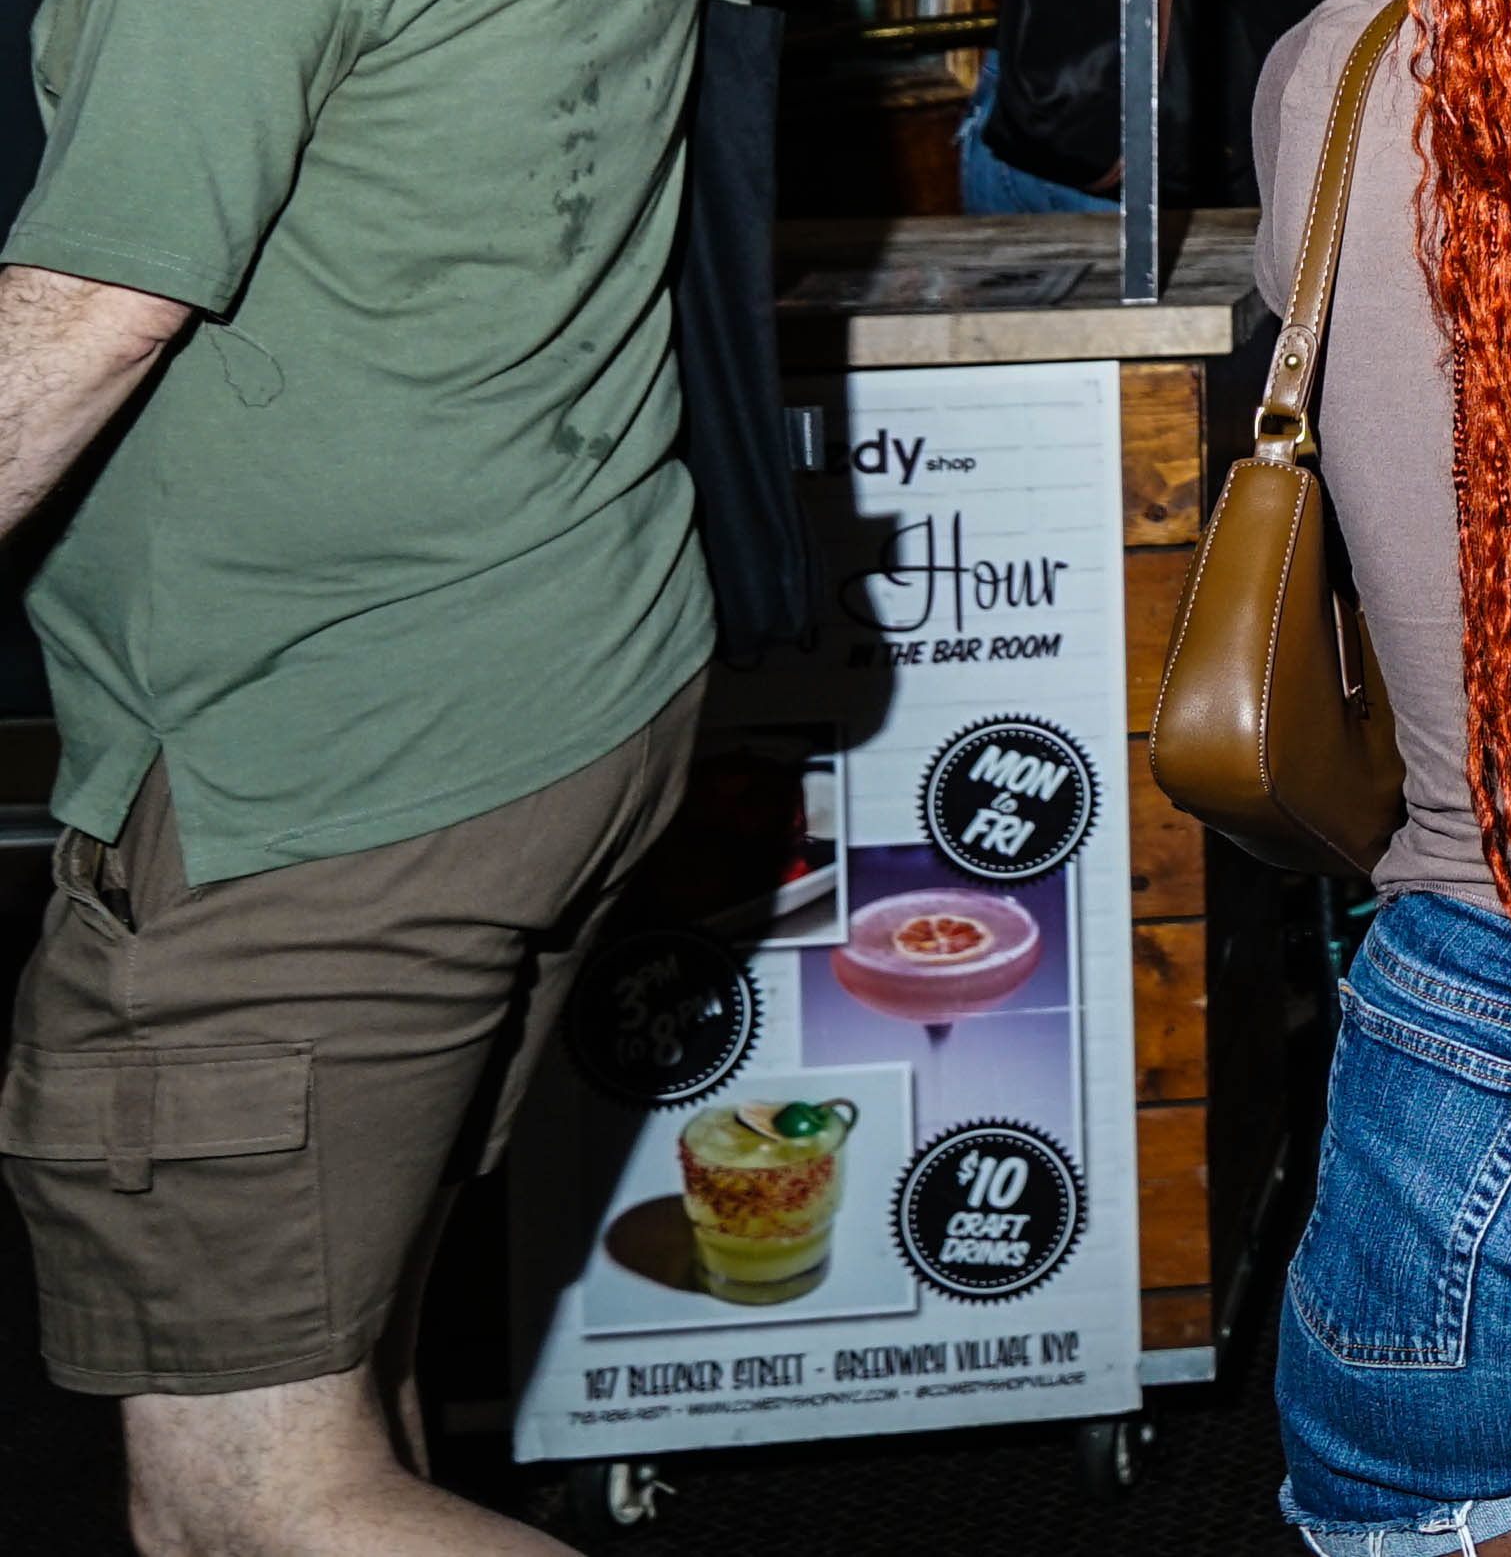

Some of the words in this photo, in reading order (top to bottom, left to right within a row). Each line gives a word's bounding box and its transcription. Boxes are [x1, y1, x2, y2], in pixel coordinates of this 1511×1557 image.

[925, 455, 977, 473] shop
[838, 509, 1070, 634] Hour
[880, 640, 927, 667] THE
[932, 637, 982, 665] BAR
[989, 633, 1063, 661] ROOM
[968, 744, 1071, 803] MON
[990, 790, 1019, 814] to
[960, 807, 1037, 858] FRI
[955, 1148, 1030, 1210] $10
[946, 1210, 1032, 1240] CRAFT
[938, 1237, 1032, 1268] DRINKS
[583, 1365, 620, 1402] 167
[626, 1360, 725, 1399] BLEECKER
[732, 1352, 807, 1391] STREET
[834, 1340, 948, 1382] GREENWICH
[953, 1333, 1032, 1372] VILLAGE
[1039, 1330, 1080, 1365] NYC
